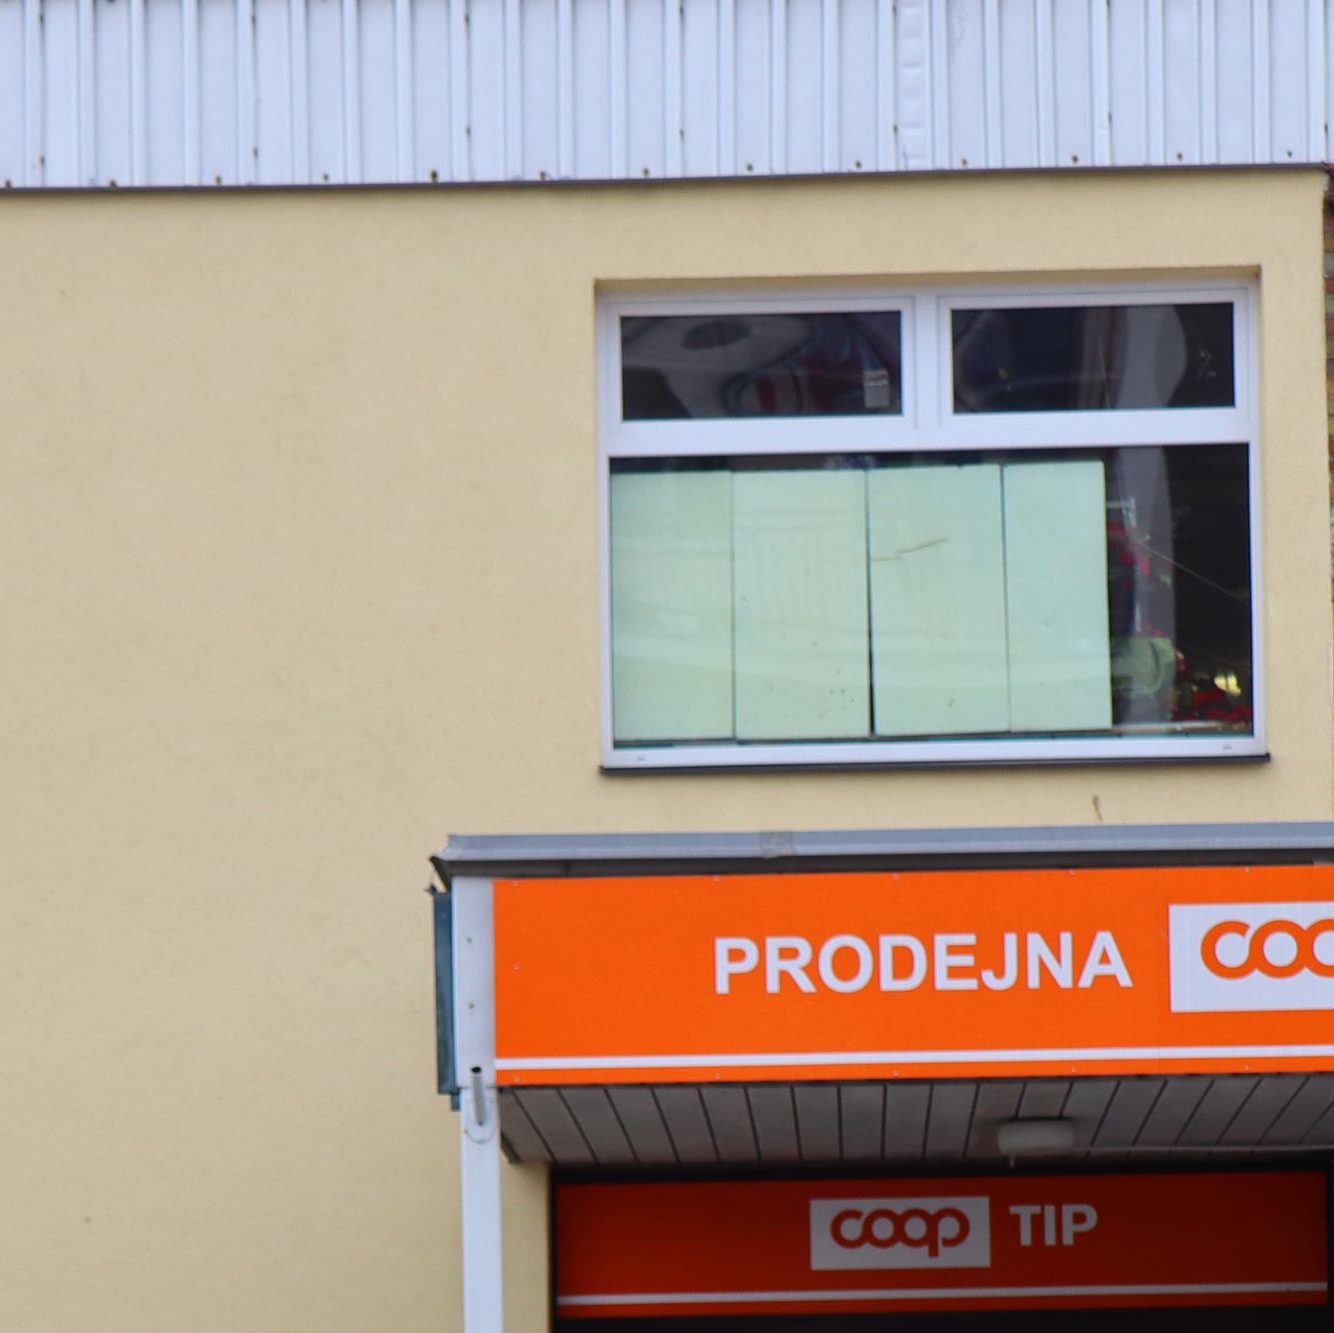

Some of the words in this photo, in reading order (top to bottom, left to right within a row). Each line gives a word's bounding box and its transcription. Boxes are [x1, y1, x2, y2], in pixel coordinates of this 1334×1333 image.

[713, 930, 1133, 996] PRODEJNA
[828, 1207, 973, 1259] coop
[1009, 1202, 1099, 1249] TIP
